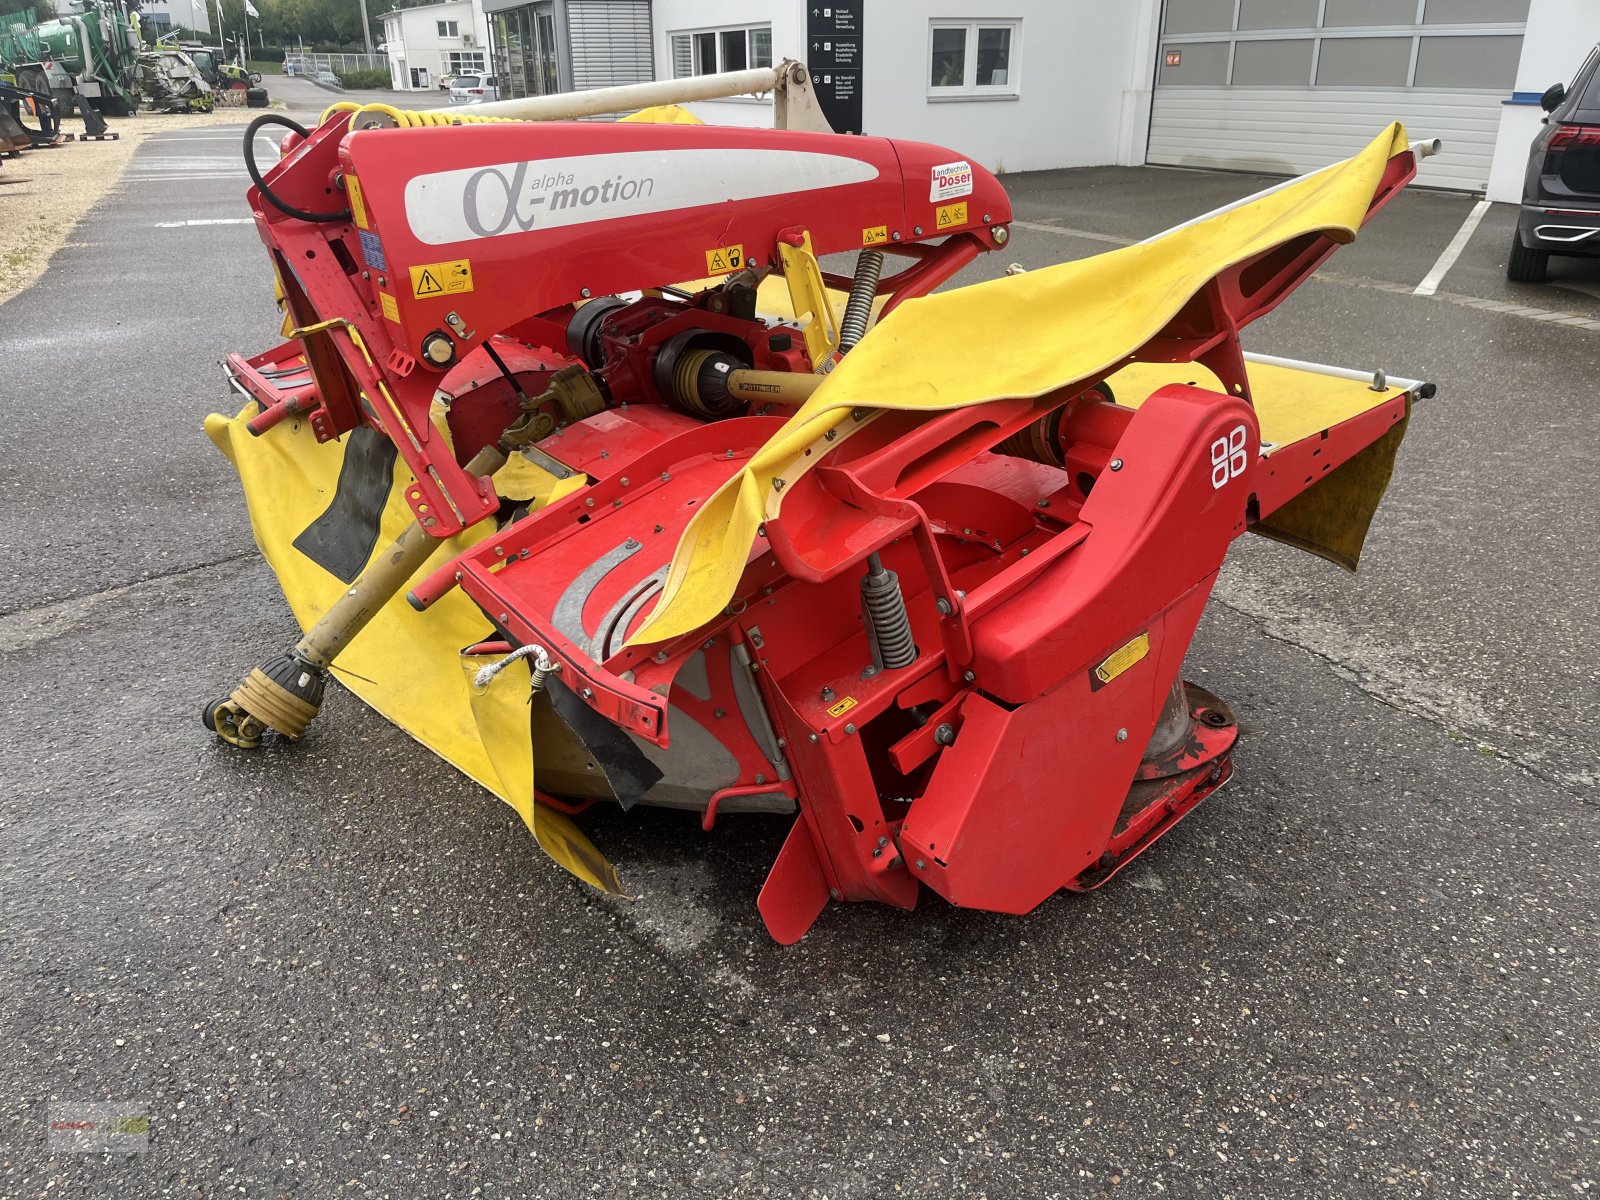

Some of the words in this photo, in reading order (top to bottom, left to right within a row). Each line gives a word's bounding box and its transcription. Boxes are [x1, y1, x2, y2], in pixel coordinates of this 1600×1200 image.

[932, 164, 970, 181] Landtechnik
[939, 173, 971, 188] Doser
[532, 173, 574, 192] alpha
